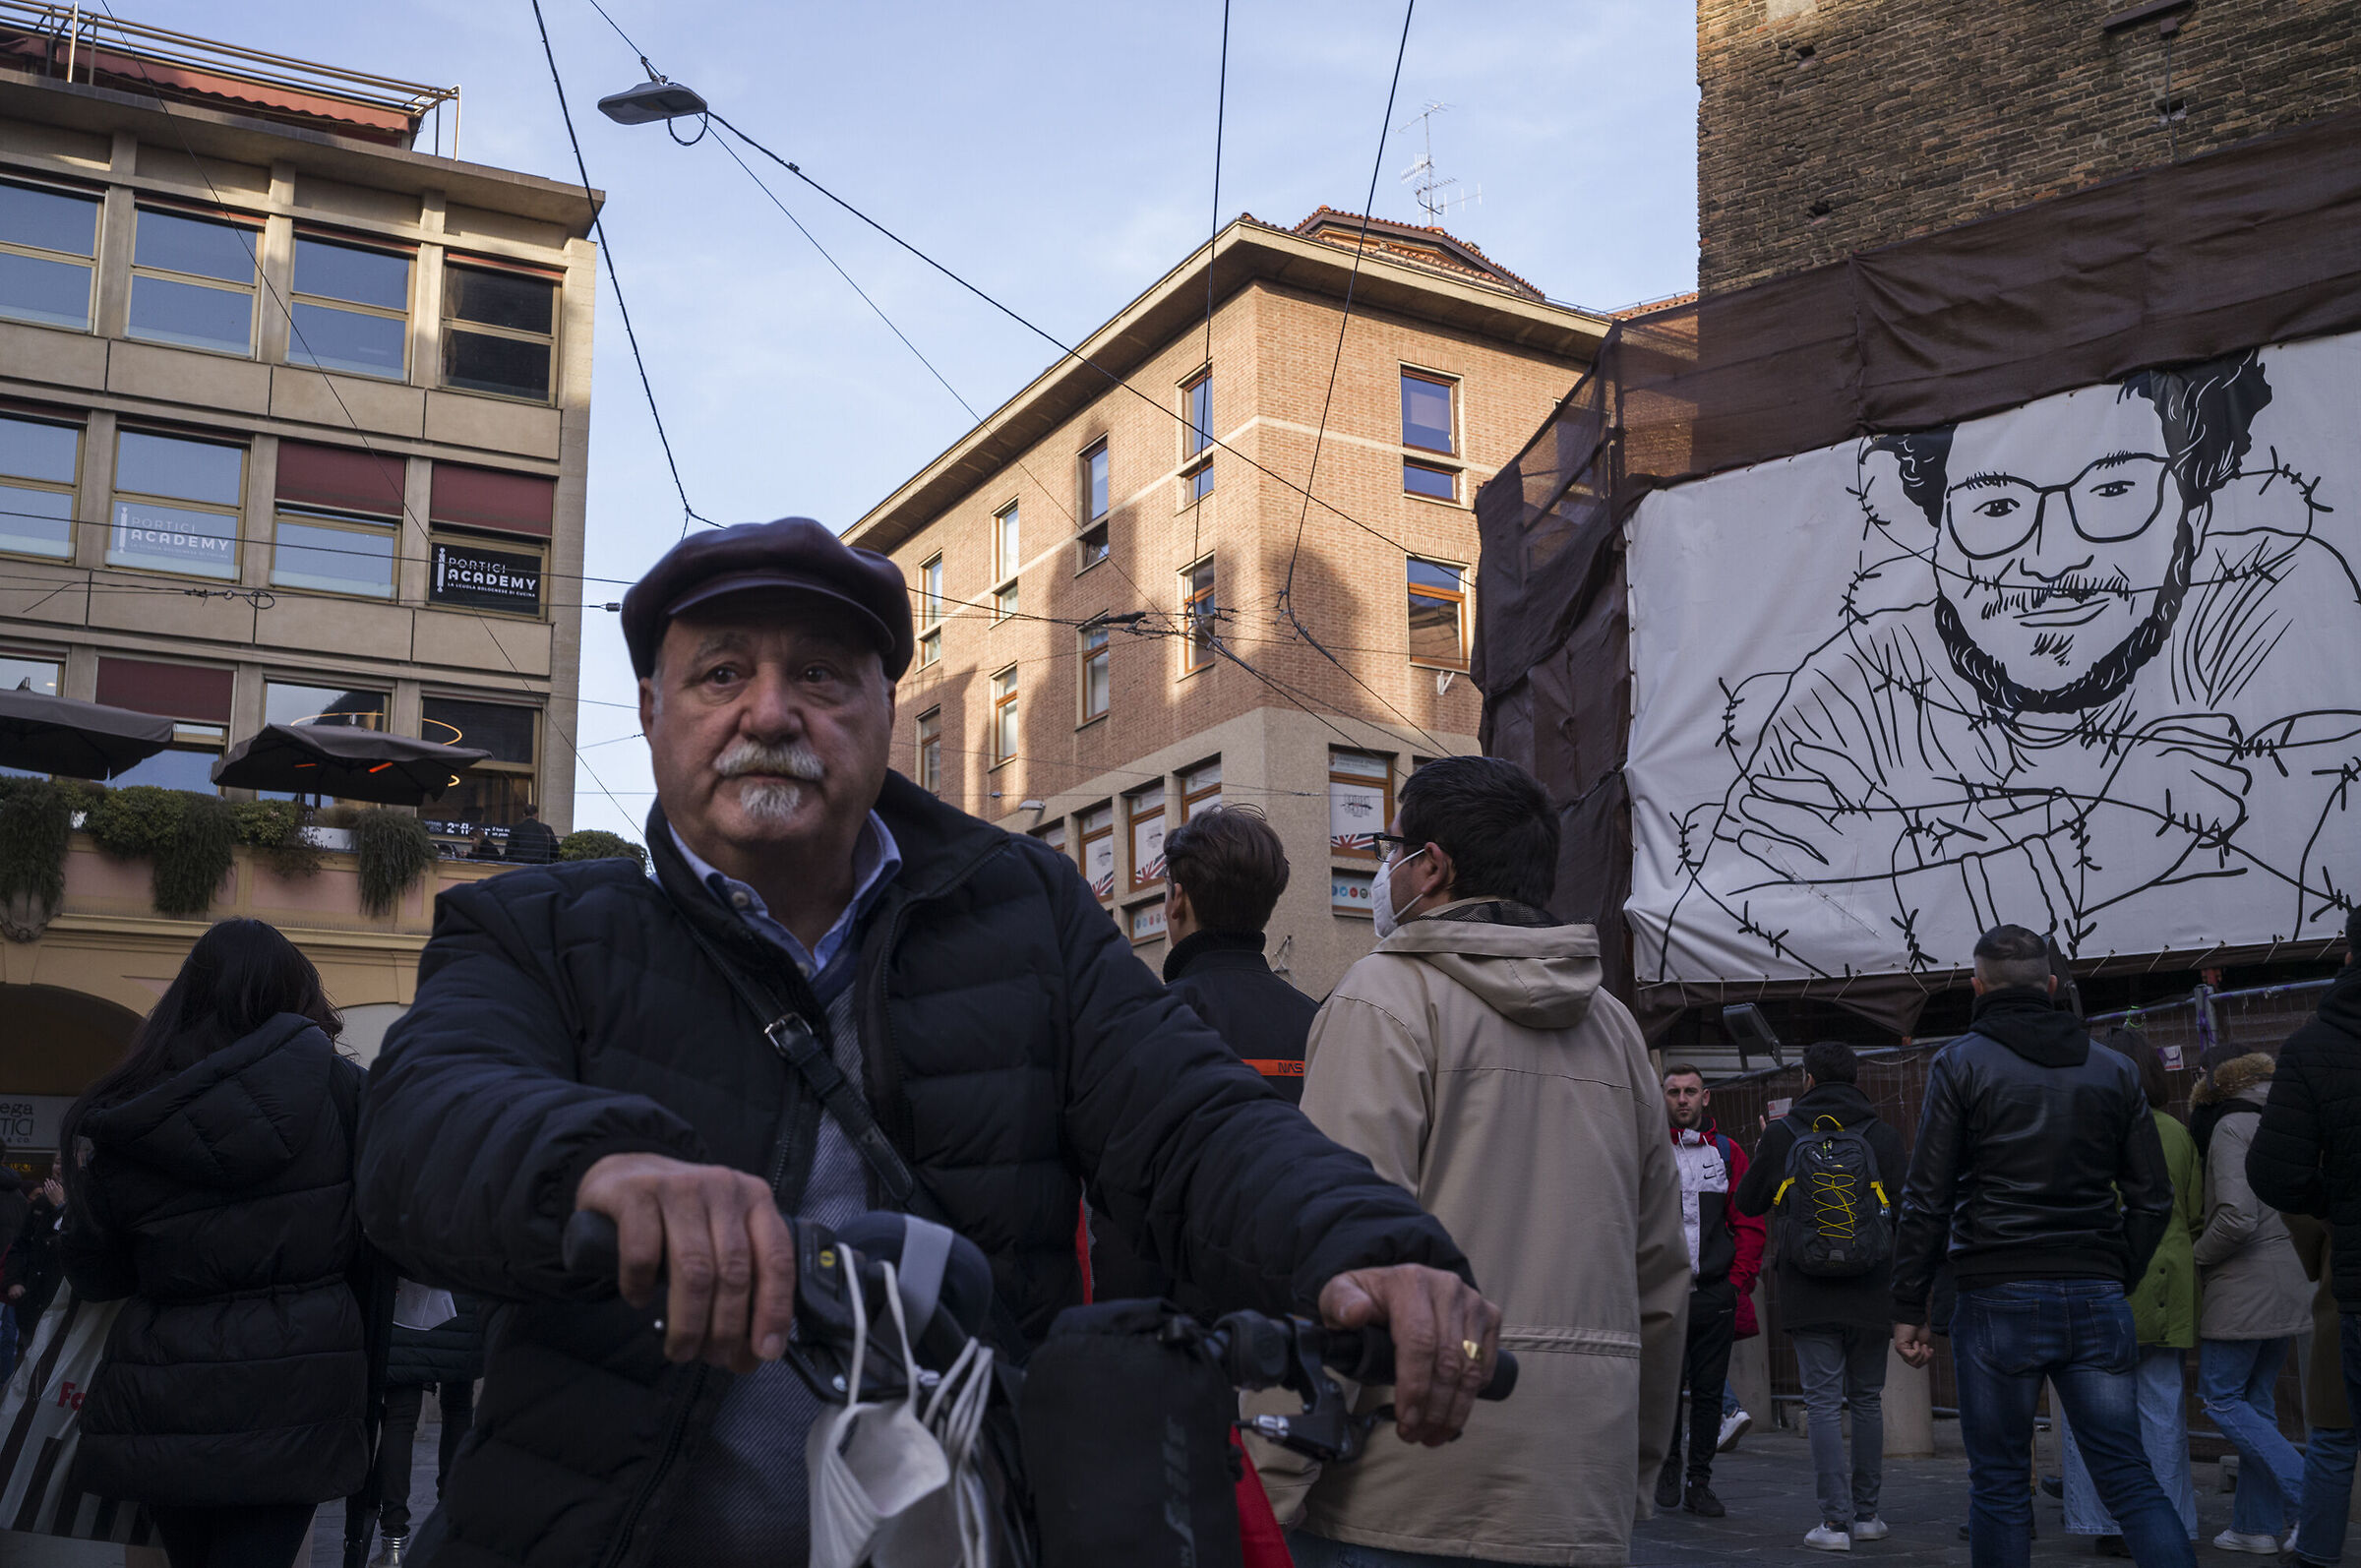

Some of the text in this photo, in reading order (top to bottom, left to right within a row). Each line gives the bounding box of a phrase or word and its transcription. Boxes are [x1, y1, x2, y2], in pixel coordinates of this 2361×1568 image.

[132, 516, 196, 533] PORTICI
[131, 529, 229, 551] ACADEMY
[449, 557, 506, 573] PORTICI
[448, 569, 536, 590] ACADEMY
